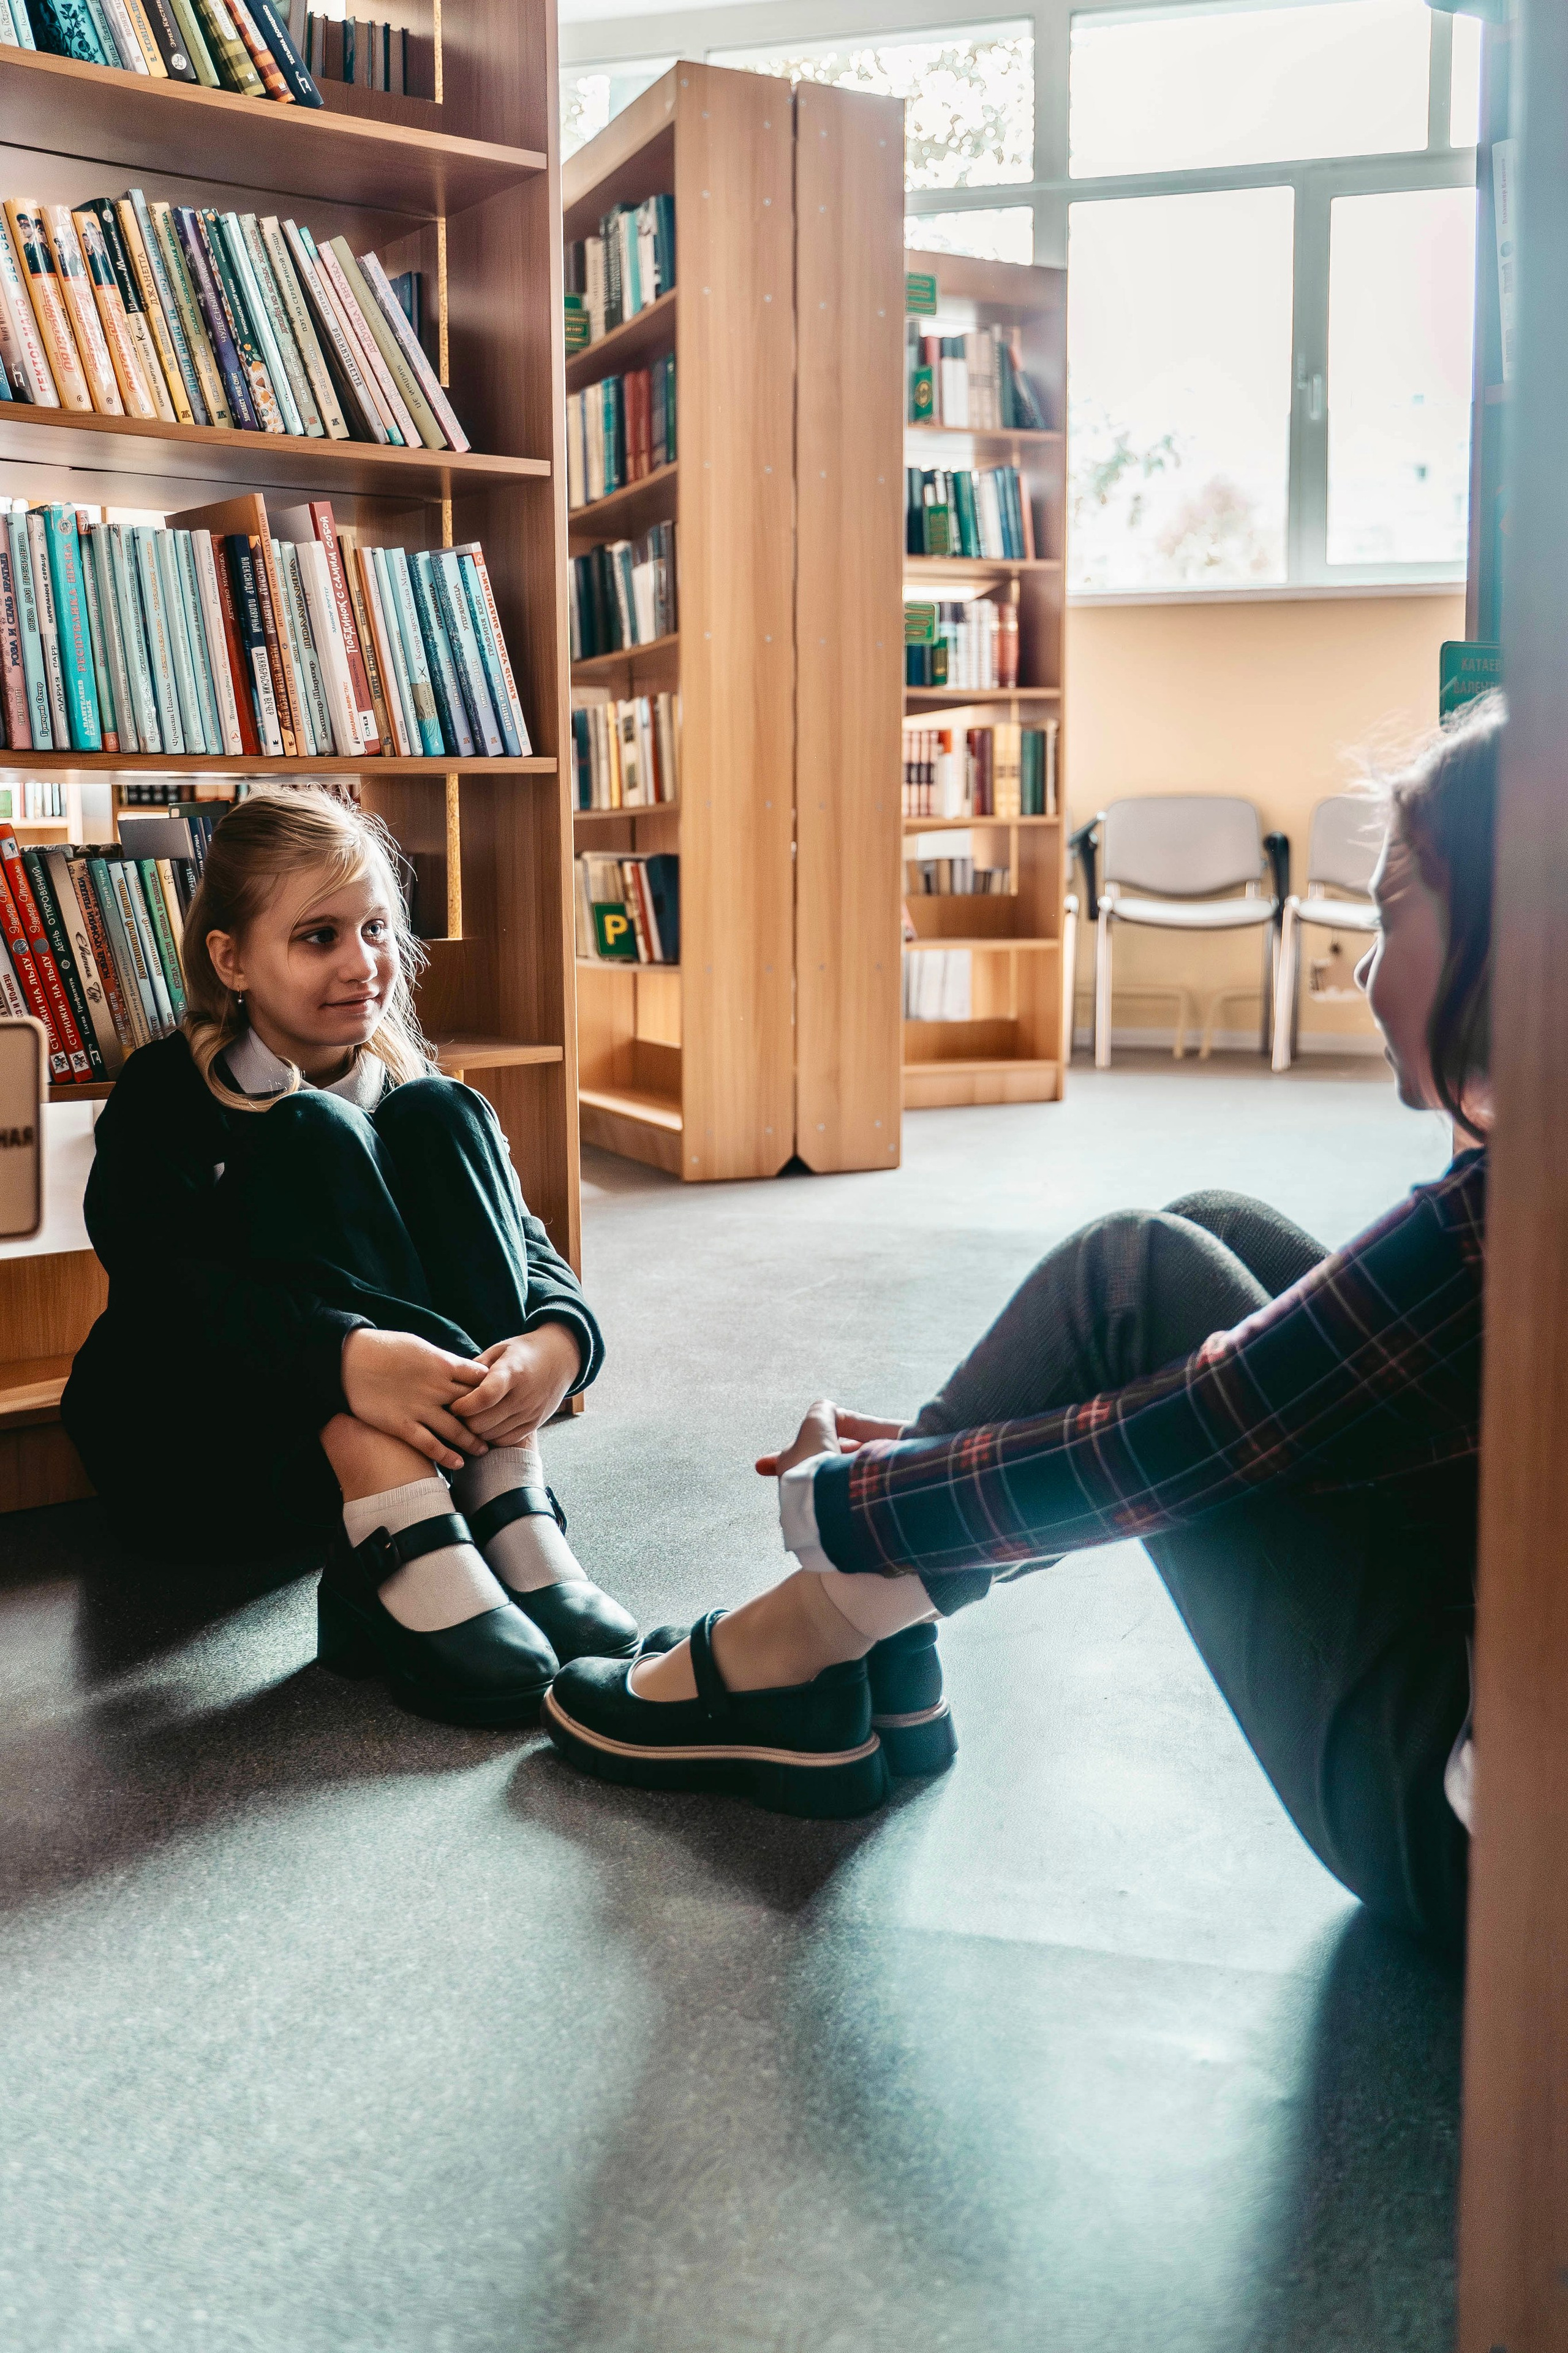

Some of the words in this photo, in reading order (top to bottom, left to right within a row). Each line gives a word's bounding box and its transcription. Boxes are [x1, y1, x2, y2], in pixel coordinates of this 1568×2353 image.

[118, 10, 132, 37] ПЕНСОВ
[262, 3, 283, 39] ДОНЦЕНКО
[279, 38, 295, 65] ТАТЬЯНА
[249, 229, 265, 263] ХОЛМОВ
[271, 232, 283, 255] РОЩИ
[4, 256, 18, 282] БЕЗ
[137, 251, 159, 306] ДЖАНЕТТА
[197, 255, 213, 292] ЗАМОК
[261, 265, 275, 295] ЯСНЫХ
[278, 257, 298, 305] СЕРЕБРЯНОЙ
[330, 262, 351, 299] ВНУЧКА
[227, 278, 236, 293] ЛУНА
[236, 305, 249, 334] ВОЛЧОНКА
[270, 295, 278, 306] ИЗ
[295, 306, 303, 316] ИЗ
[14, 297, 34, 338] МАЛО
[208, 291, 228, 343] ЧУДЕСНЫЙ
[299, 317, 307, 332] ПЭТ
[352, 309, 377, 355] ДЕДУШКА
[27, 340, 50, 393] ГЕКТОР
[142, 342, 151, 360] ГАЙТЕ
[332, 327, 362, 387] РОБИНЗОНЕТТА
[148, 361, 158, 384] МАРТИН
[396, 364, 415, 396] МИЛЫЙ
[155, 385, 164, 407] КАРМЕН
[238, 398, 251, 422] ЭЛИЗАБЕТ
[300, 389, 309, 404] ЛЮСИ
[260, 512, 273, 564] СОЛДАТИКОВ
[319, 515, 334, 550] СОБОЙ
[0, 553, 11, 594] БРАТЬЕВ
[18, 532, 31, 585] ПРЕЗИДЕНТА
[39, 553, 48, 580] СЕРДЦЕ
[63, 542, 75, 583] ШКИД
[204, 545, 214, 575] Перлова
[218, 553, 229, 587] МАВРИКА
[327, 551, 343, 590] САМИМ
[397, 557, 408, 586] Марни
[24, 587, 33, 605] ДЛЯ
[43, 583, 53, 623] ВАФЕЛЬНОЕ
[209, 577, 218, 605] Евгения
[224, 589, 235, 621] ДЕТСТВО
[239, 556, 254, 594] АЛЕКСАНДР
[247, 598, 262, 632] ПОЛЯРНЫЙ
[254, 558, 268, 596] АЛЕКСАНДР
[262, 600, 275, 633] ПОЛЯРНЫЙ
[288, 558, 311, 649] ПОЛЛИАННА
[323, 586, 333, 609] ПОРТЕР
[336, 591, 345, 599] С
[402, 588, 412, 609] была
[428, 581, 443, 630] УПРЯМИЦА
[474, 594, 484, 615] КЕЙТ
[480, 571, 499, 629] АНДРЕЕВИЧ
[4, 595, 15, 624] СЕМЬ
[26, 608, 36, 632] ЮБКА
[273, 592, 283, 627] ИСТОРИЯ
[328, 610, 337, 633] ЭЛИНОР
[408, 611, 417, 633] здесь
[453, 583, 469, 632] УПРЯМИЦА
[8, 627, 15, 636] И
[69, 588, 86, 673] РЕСПУБЛИКА
[92, 610, 106, 667] Великолепная
[337, 599, 359, 654] ПОЕДИНОК
[480, 618, 494, 657] ГРАФИНЯ
[9, 640, 20, 666] РОЗА
[365, 644, 376, 671] ПРОСТО
[412, 635, 422, 660] Когда
[496, 632, 508, 665] УДАЧА
[34, 682, 45, 703] Остер
[55, 676, 64, 712] МАРИЯ
[255, 651, 271, 694] ДЕКАБРЬСКИЙ
[263, 697, 274, 716] ВЕЧЕР
[274, 673, 285, 693] ВЕТВИ
[285, 663, 295, 694] ПОПОВ
[307, 660, 322, 699] Портер
[370, 674, 381, 700] ДАВИД
[496, 686, 505, 701] МЭРИ
[504, 667, 517, 699] КНЯЗЬ
[164, 682, 173, 712] Паскаль
[342, 681, 352, 709] ВЫРАСТАЕТ
[478, 692, 488, 708] ЭММИ
[37, 705, 49, 737] Григорий
[291, 700, 301, 731] РЮРИК
[315, 700, 328, 740] Элинор
[500, 702, 513, 731] ШАРЛОТТА
[10, 864, 30, 903] Тополь
[31, 865, 57, 926] ОТКРОВЕНИЙ
[77, 876, 92, 910] РЕБЕККИ
[102, 886, 113, 908] Сергей
[116, 877, 133, 920] ДЯДЮШКА
[149, 871, 162, 904] КОЛЛЕДЖ
[3, 902, 21, 934] Эдуард
[23, 902, 42, 934] Эдуард
[86, 910, 103, 950] ХРОНИКИ
[158, 913, 170, 939] ПОШЛА
[51, 929, 65, 953] ДЕНЬ
[74, 930, 96, 979] Евгения
[124, 919, 147, 981] ДЛИННОНОГИЙ
[165, 942, 176, 964] ПЭТТИ
[21, 955, 39, 986] ЛЬДУ
[41, 954, 56, 982] ЛЬДУ
[97, 950, 111, 980] НОВЫЕ
[170, 967, 181, 989] КОГДА
[2, 973, 18, 1002] ПЕНРОД
[32, 988, 43, 1003] НА
[51, 984, 61, 998] НА
[67, 977, 84, 1013] Трофимчук
[38, 1005, 59, 1050] СТРИЖИ
[79, 1015, 90, 1035] Елена
